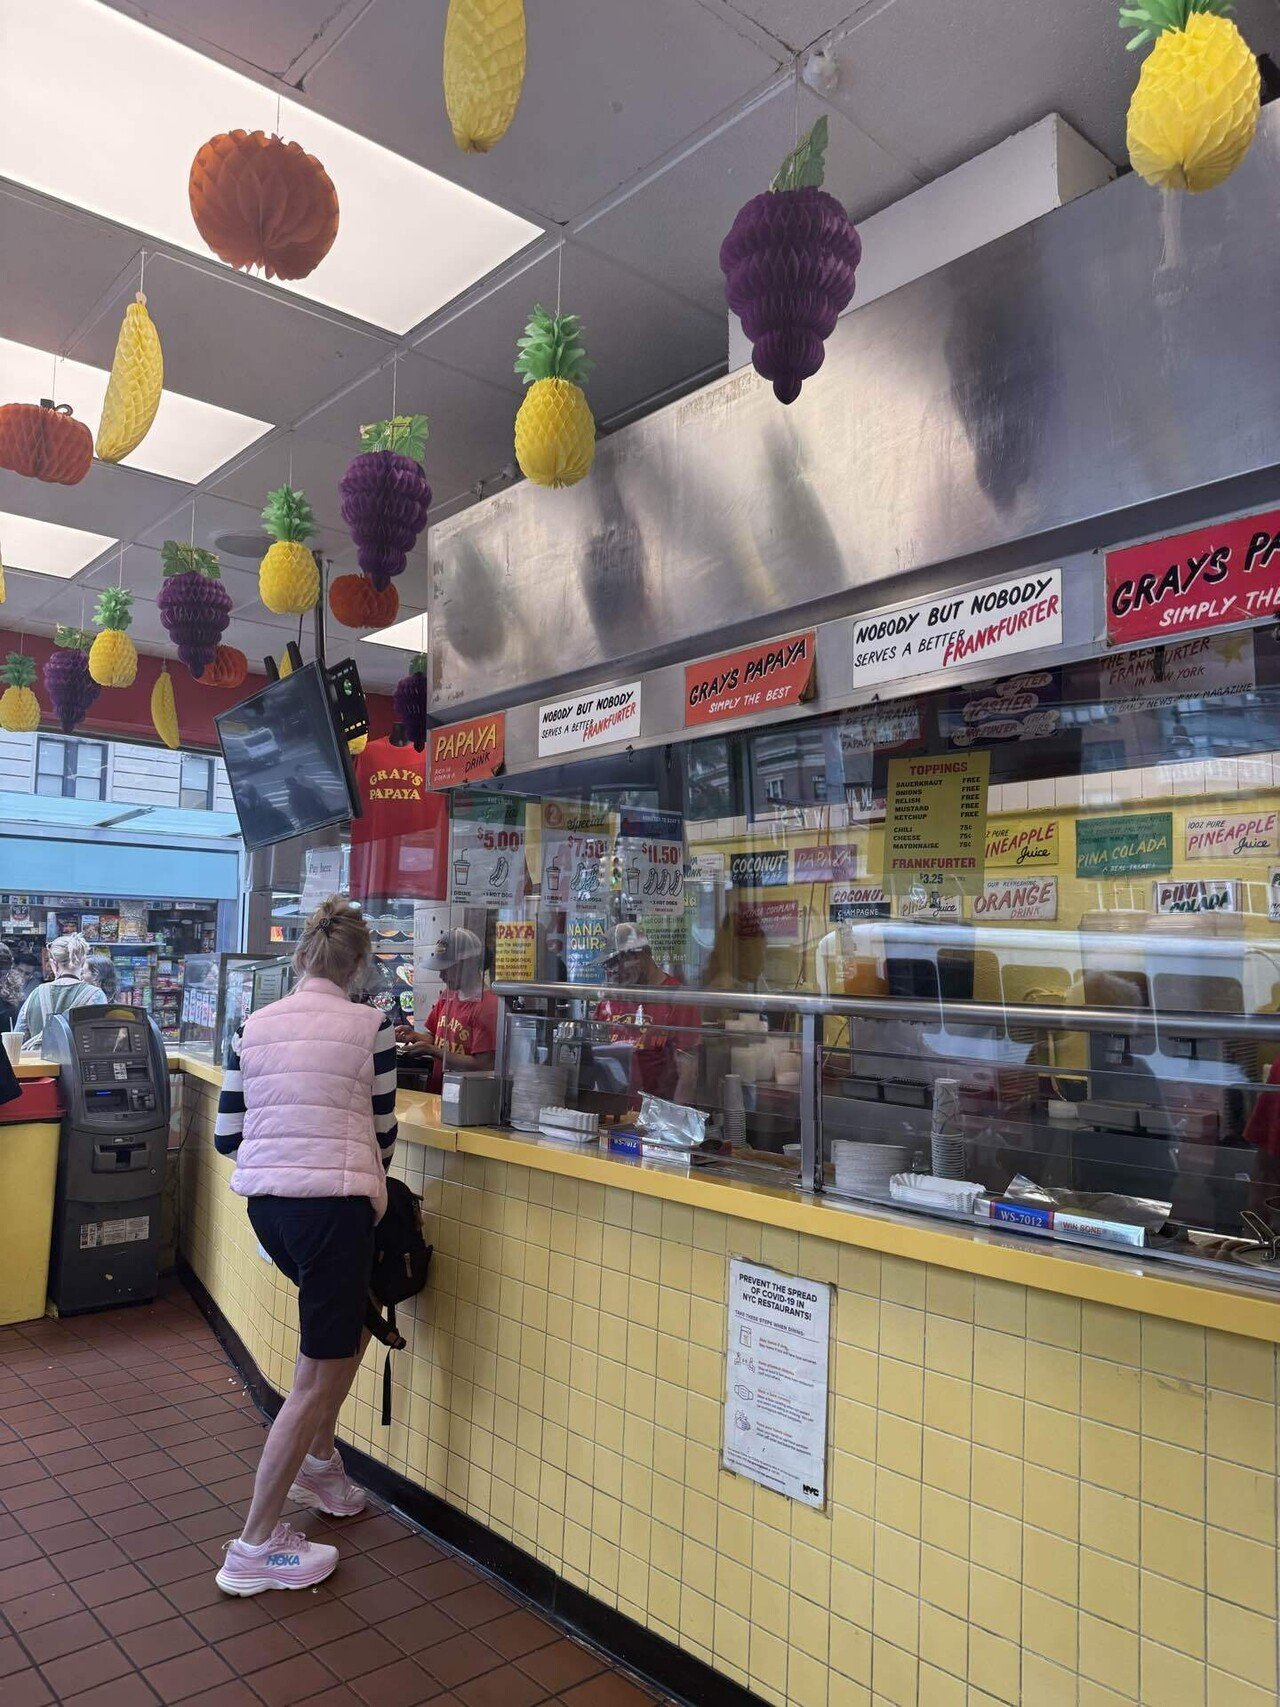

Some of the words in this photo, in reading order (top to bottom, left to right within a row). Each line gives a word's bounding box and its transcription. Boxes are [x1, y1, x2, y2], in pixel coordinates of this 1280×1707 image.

[856, 612, 920, 644] NOBODY
[928, 600, 964, 626] BUT
[970, 577, 1053, 615] NOBODY
[1159, 595, 1238, 627] SIMPLY
[854, 646, 896, 667] SERVES
[902, 642, 912, 655] A
[918, 629, 966, 653] BETTER
[943, 594, 1059, 667] FRANKFURTER
[744, 638, 807, 684] PAPAYA
[1109, 639, 1210, 685] FRANKURTER
[1128, 646, 1157, 661] BES
[1134, 675, 1146, 688] IN
[1149, 671, 1173, 686] NW
[1174, 665, 1207, 680] YORK
[709, 696, 741, 713] SIMPLY
[744, 692, 761, 705] THE
[766, 685, 792, 701] BEST
[1202, 683, 1253, 699] MAGAZINE
[542, 705, 574, 724] NOBODY
[576, 701, 593, 716] BUT
[596, 691, 634, 711] NOBODY
[541, 726, 562, 739] SERVES
[564, 724, 569, 733] A
[571, 718, 593, 733] BETTER
[582, 702, 637, 742] FRANKFURTER
[435, 724, 497, 762] PAPAYA
[465, 751, 491, 774] DRINK
[910, 762, 968, 776] TOPPINGS
[369, 768, 424, 787] GRAY'S
[896, 779, 943, 788] SAUERKRAUT
[369, 788, 421, 800] PAPAYA
[990, 828, 1009, 838] PURE
[1188, 814, 1276, 851] PINEAPPLE
[1206, 820, 1226, 828] PURE
[985, 822, 1055, 858] INEAPPLE
[1233, 837, 1270, 855] Juice
[797, 850, 850, 869] PAPAYA
[1016, 845, 1050, 865] Juice
[1077, 850, 1108, 868] PINA
[1112, 836, 1167, 860] COLADA
[732, 855, 787, 873] COCONUT
[892, 857, 976, 869] FRANKFURTER
[920, 873, 944, 885] $3.25
[833, 889, 884, 903] COCONUT
[973, 882, 1054, 914] ORANGE
[838, 908, 878, 917] CHAMPAGNE
[1010, 907, 1041, 919] DRINK
[496, 925, 534, 939] PAYA
[1000, 1211, 1043, 1227] WS-7012
[739, 1273, 771, 1288] PREVENT
[772, 1283, 786, 1294] THE
[787, 1288, 818, 1303] SPREAD
[742, 1293, 756, 1303] NYC
[757, 1299, 812, 1321] RESTAURANTS!
[750, 1287, 761, 1295] OF
[762, 1289, 795, 1306] COVID-19
[796, 1300, 805, 1309] IN
[759, 1317, 772, 1326] STEPS
[802, 1484, 819, 1497] NYC
[265, 1554, 300, 1566] HOKA
